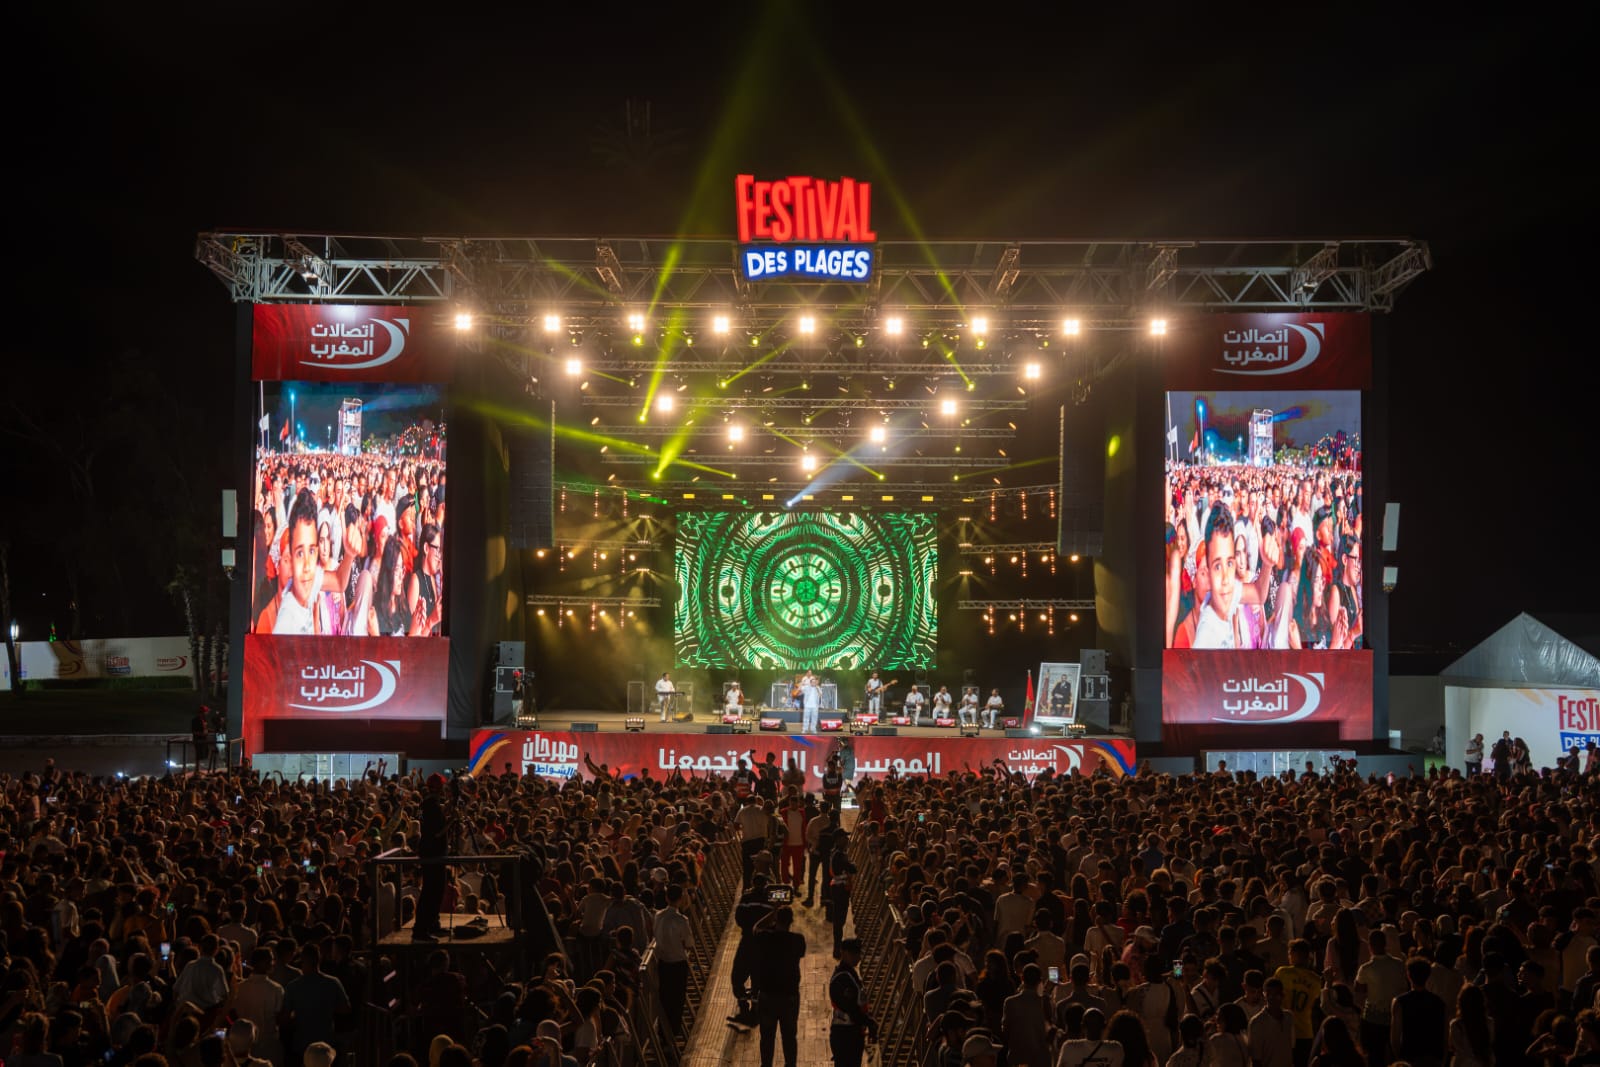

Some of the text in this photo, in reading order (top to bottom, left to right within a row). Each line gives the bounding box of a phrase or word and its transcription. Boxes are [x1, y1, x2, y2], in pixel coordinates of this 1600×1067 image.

[735, 174, 877, 243] FESTIVAL
[746, 249, 871, 279] DES PLAGES
[311, 323, 374, 338] اتصالات
[1223, 328, 1289, 343] اتصالات
[311, 340, 374, 359] المغرب
[1223, 345, 1289, 366] المغرب
[301, 665, 365, 680] اتصالات
[301, 682, 365, 702] المغرب
[1223, 678, 1289, 693] اتصالات
[1223, 695, 1289, 715] المغرب
[1558, 695, 1600, 731] FESTI
[522, 733, 578, 763] مهرجان
[1564, 736, 1587, 750] DES
[1008, 748, 1057, 761] اتصالات
[534, 764, 575, 777] الشواط
